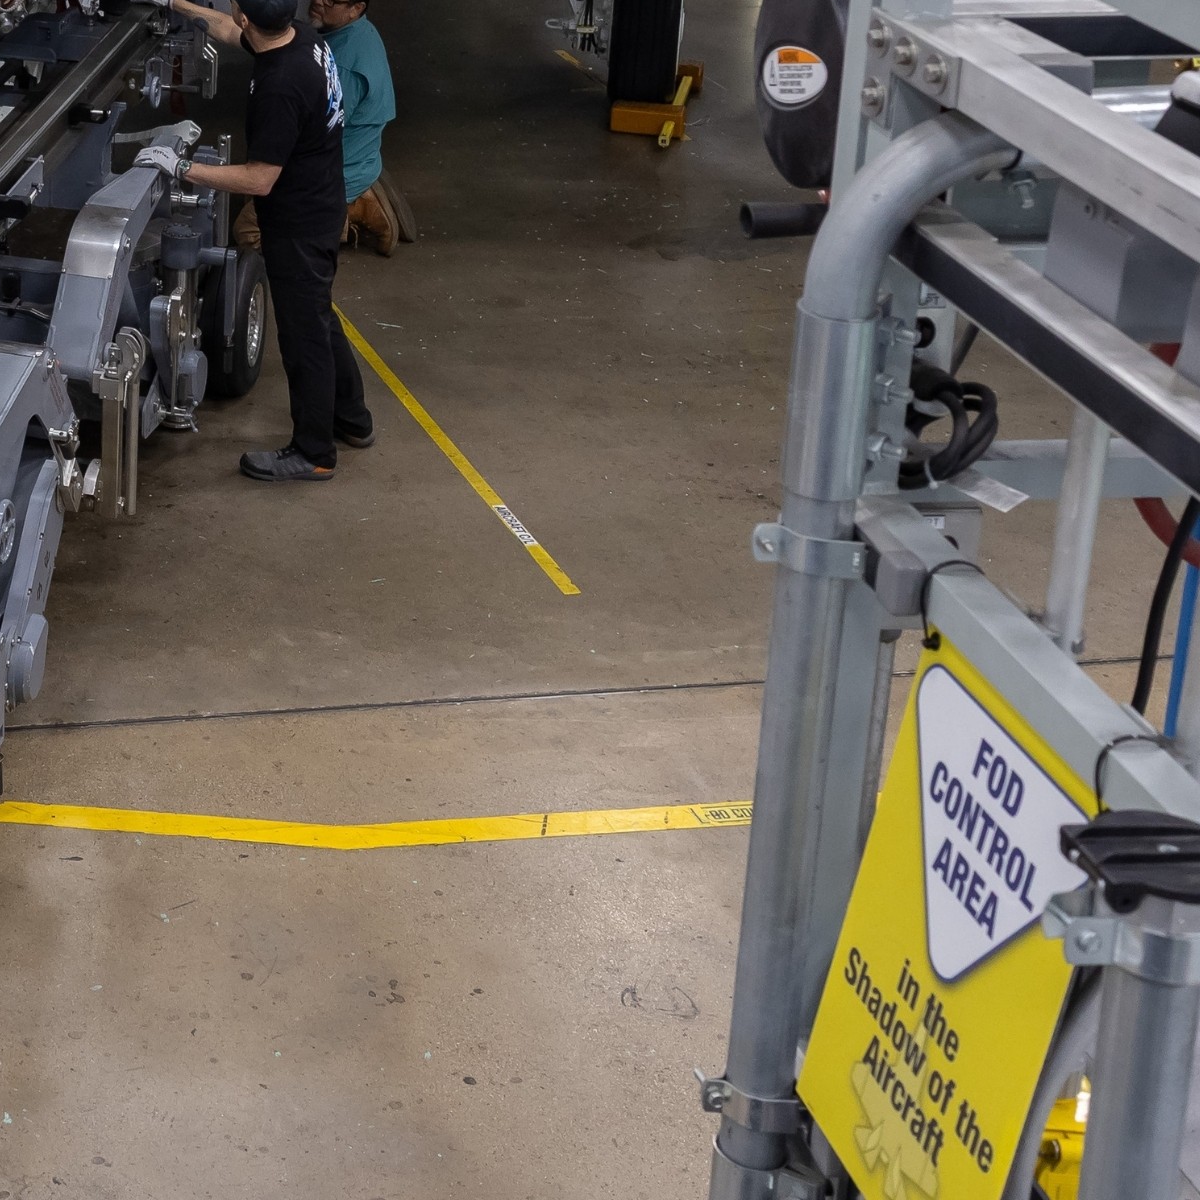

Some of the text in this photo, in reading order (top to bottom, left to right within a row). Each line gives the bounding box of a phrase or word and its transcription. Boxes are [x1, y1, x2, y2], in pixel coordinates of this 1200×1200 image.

[495, 506, 527, 534] AIRCRAFT
[972, 738, 1024, 818] FOD
[930, 761, 1036, 913] CONTROL
[932, 837, 999, 941] AREA
[844, 947, 994, 1173] Shadow of the
[897, 959, 960, 1062] in the
[862, 1035, 945, 1168] Aircraft
